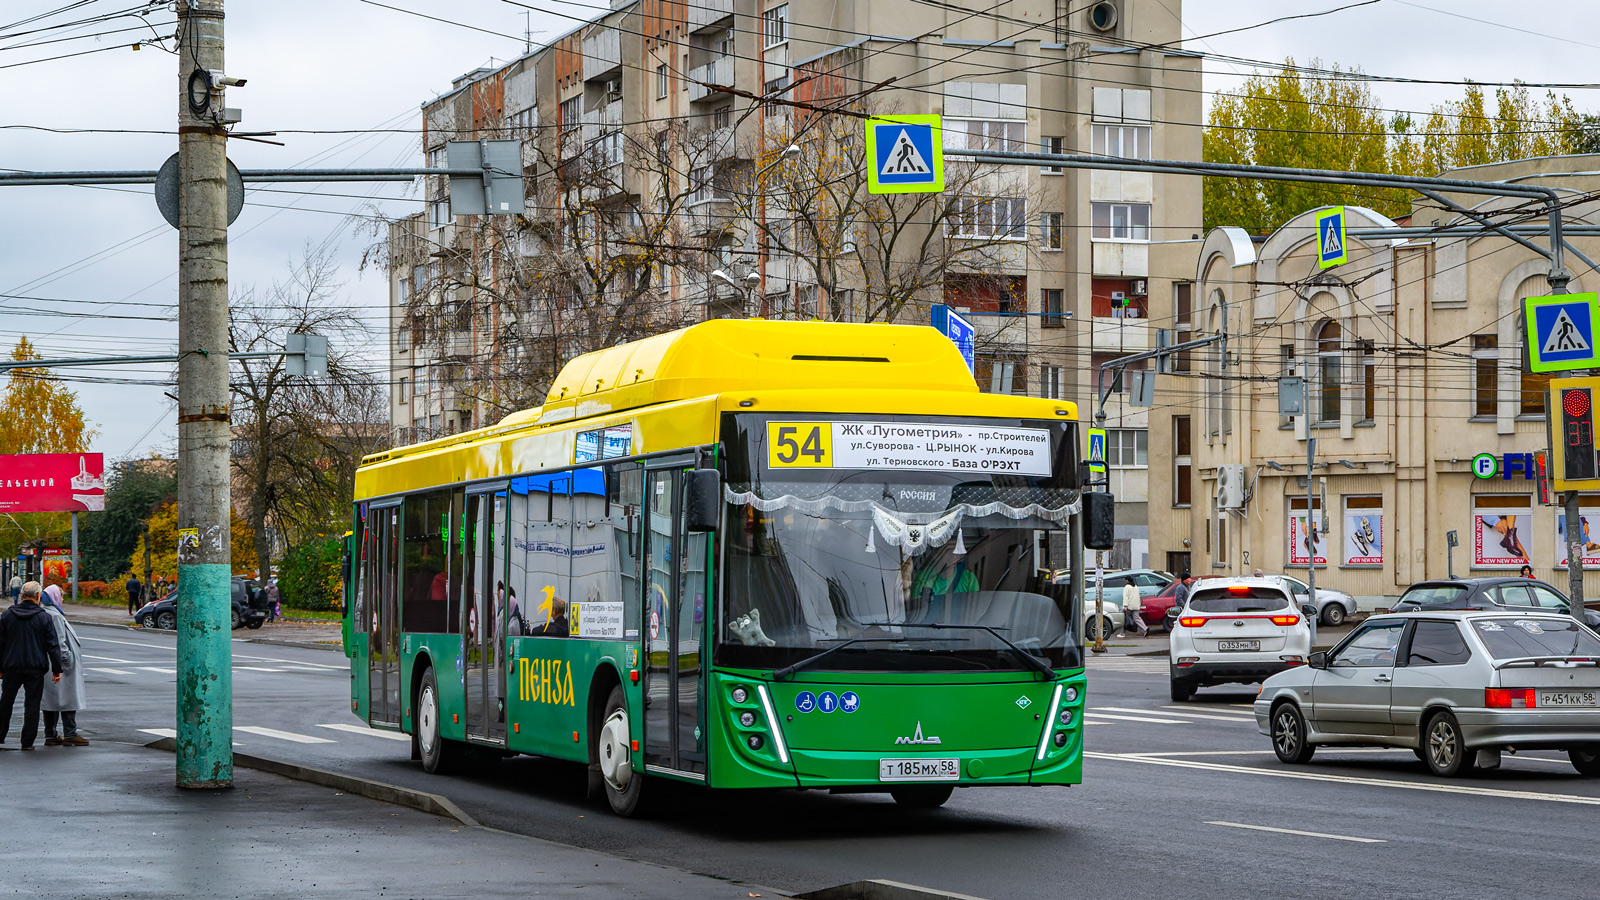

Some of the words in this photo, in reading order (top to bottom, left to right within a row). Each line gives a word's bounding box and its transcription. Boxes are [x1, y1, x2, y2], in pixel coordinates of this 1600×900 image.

[841, 424, 864, 436] ЖК
[866, 426, 962, 440] «Лугометрия»
[978, 431, 1046, 443] пр.Строителей
[1569, 421, 1592, 446] 37
[776, 426, 825, 464] 54
[850, 442, 914, 451] ул.Суворова
[926, 442, 976, 454] Ц.РЫНОК
[986, 446, 1034, 457] ул.Кирова
[866, 458, 880, 466] ул.
[883, 458, 944, 468] Терновского
[952, 458, 978, 468] База
[900, 490, 936, 500] РОССИЯ
[520, 658, 575, 706] ПЕНЗА
[1584, 693, 1592, 701] 58
[941, 761, 954, 771] 58
